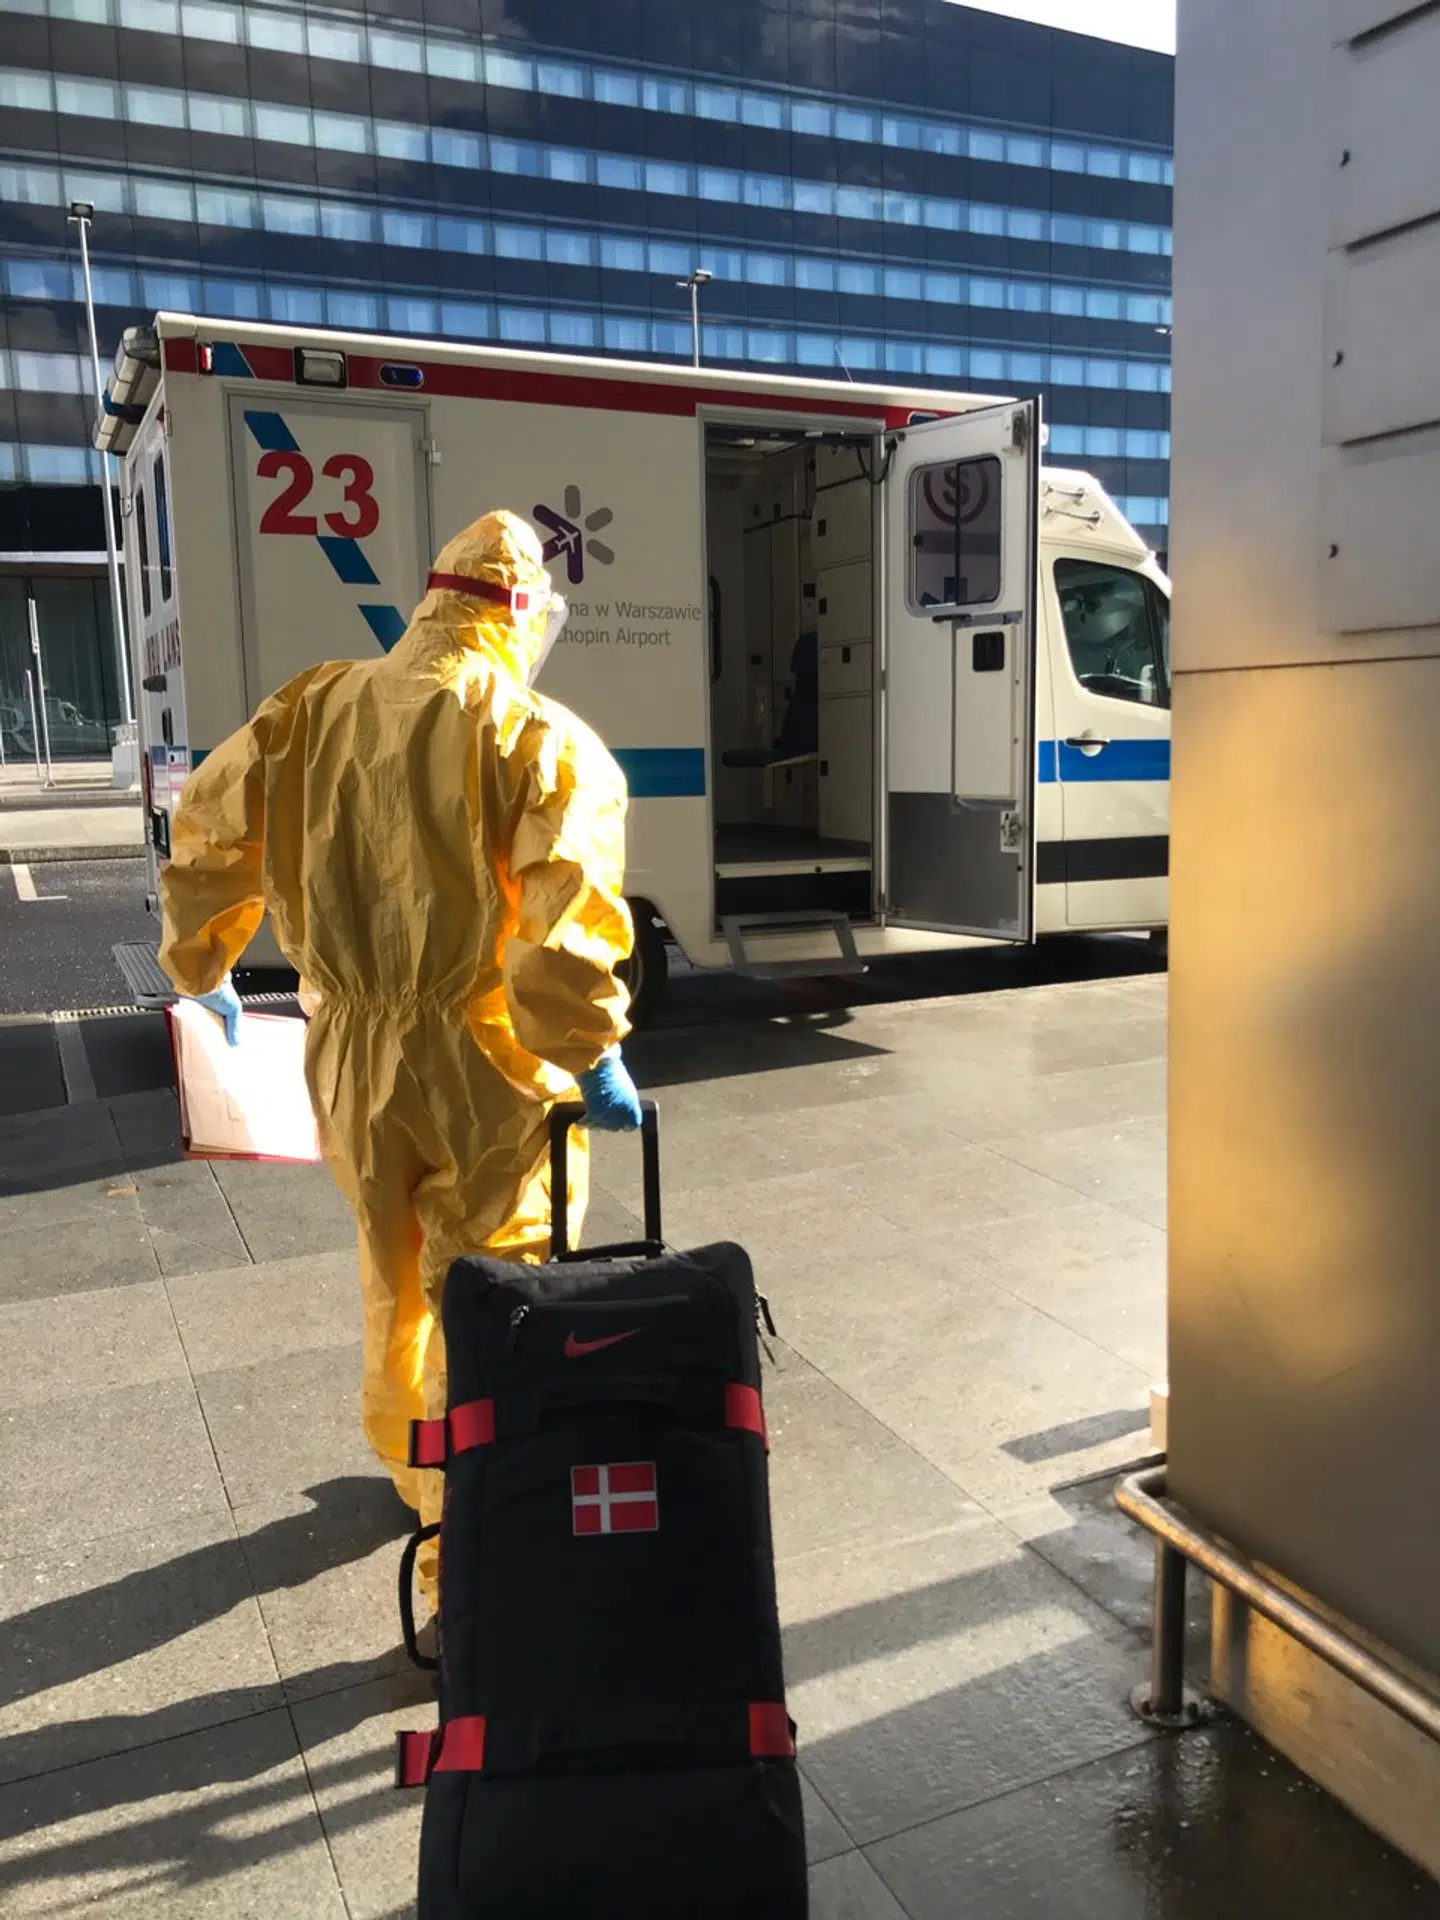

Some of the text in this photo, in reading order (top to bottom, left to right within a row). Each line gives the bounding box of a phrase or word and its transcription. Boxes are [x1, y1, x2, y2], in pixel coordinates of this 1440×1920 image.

[256, 450, 380, 539] 23
[566, 601, 702, 622] na w Warszawie
[614, 628, 672, 648] Airport
